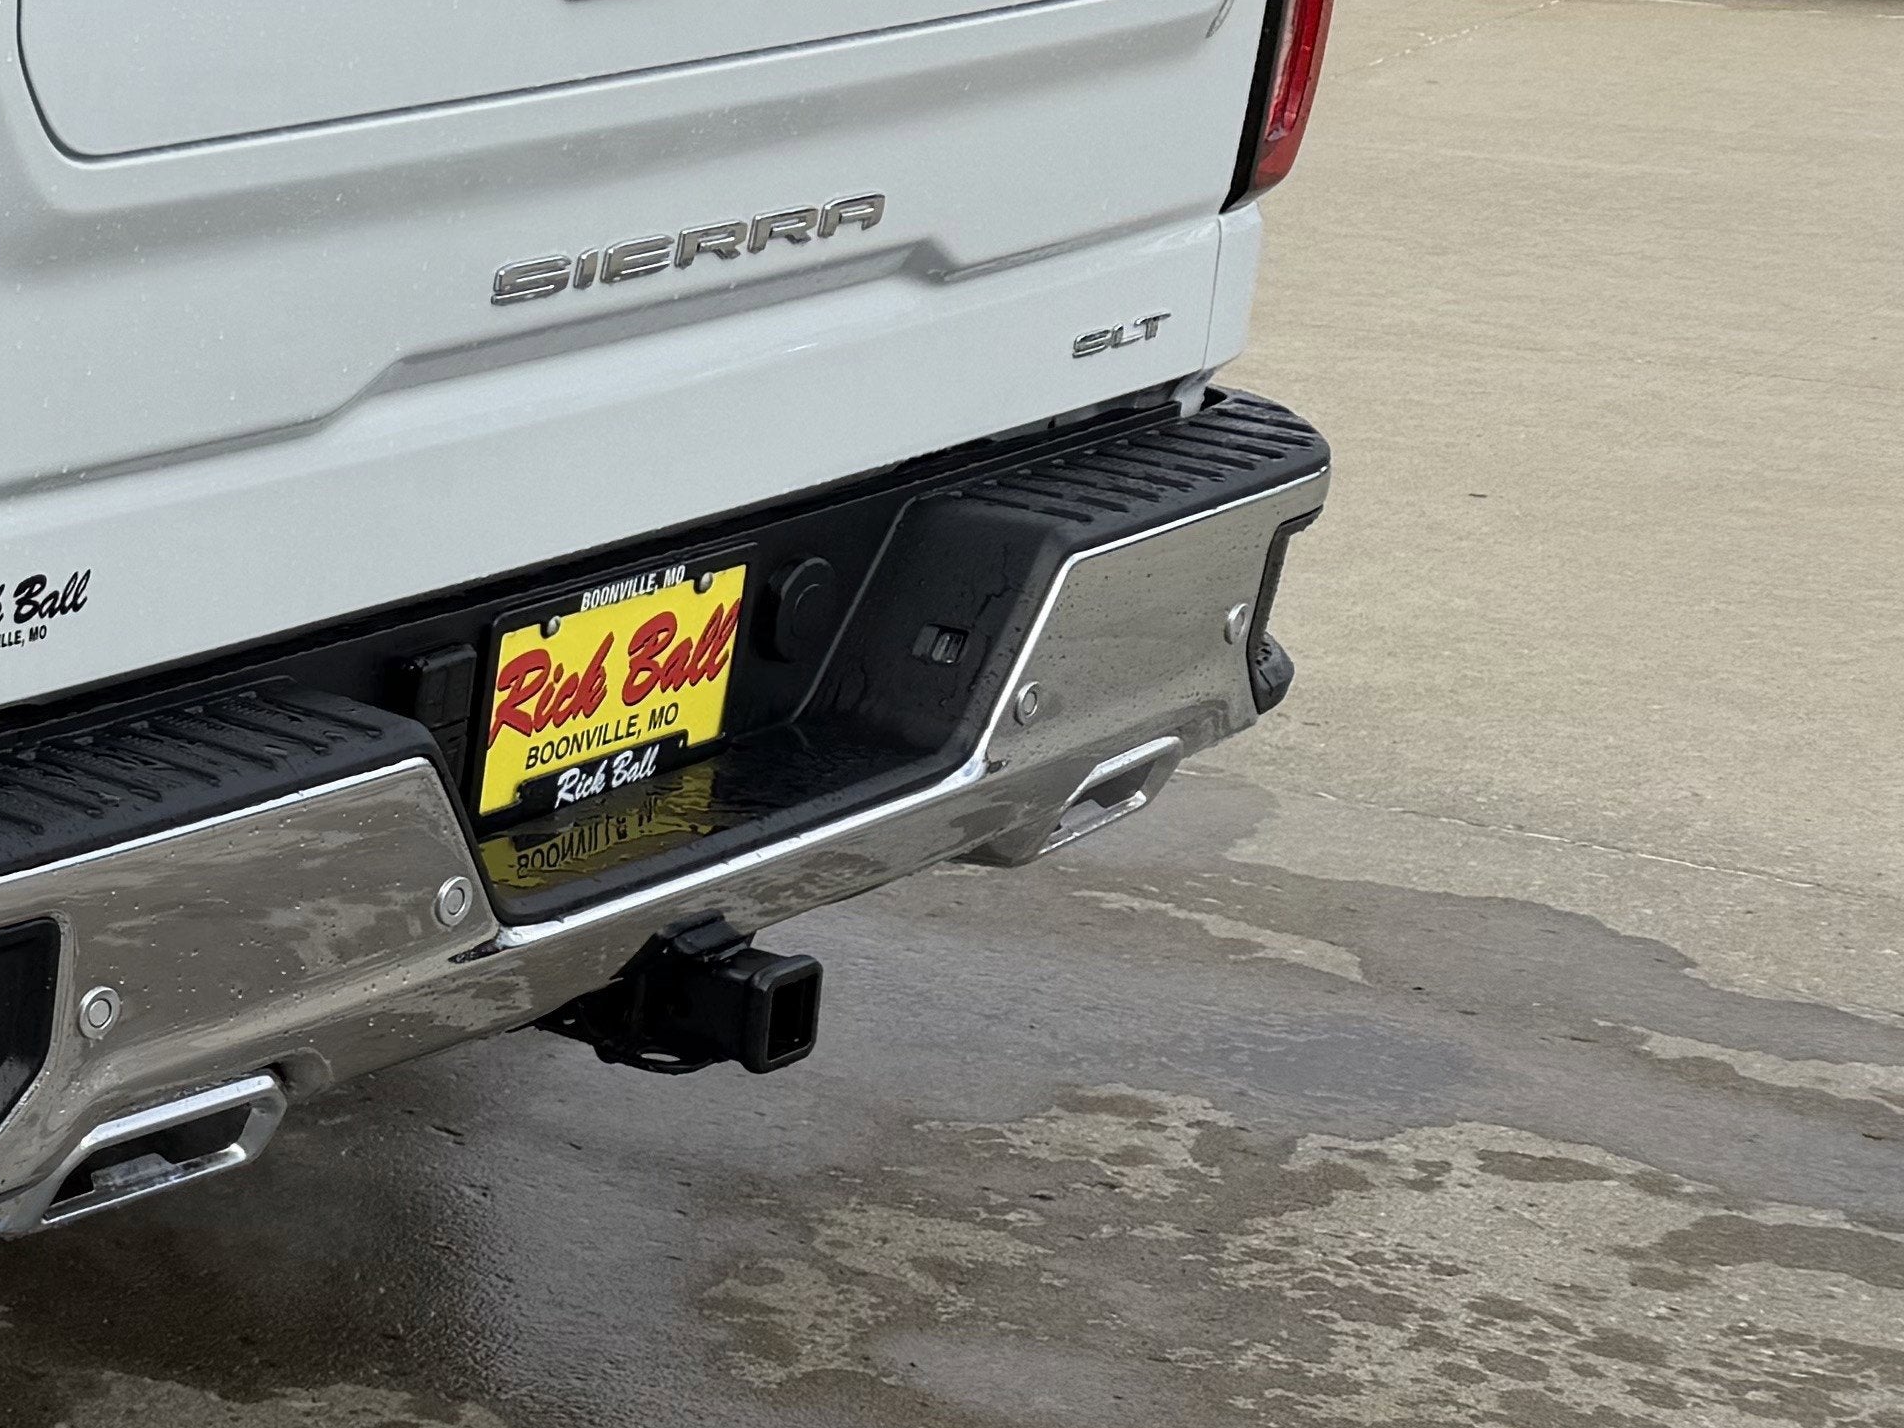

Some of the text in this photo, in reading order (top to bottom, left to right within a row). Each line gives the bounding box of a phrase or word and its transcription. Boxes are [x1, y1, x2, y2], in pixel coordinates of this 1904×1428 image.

[491, 191, 887, 307] SIERRA
[1072, 311, 1172, 359] SLT
[12, 568, 92, 625] Ball
[580, 564, 686, 612] BOONVILLE, MO
[29, 624, 48, 642] MO
[486, 598, 743, 750] Rick Ball
[525, 702, 679, 770] BOONVILLE, MO
[554, 744, 660, 810] Rick Ball
